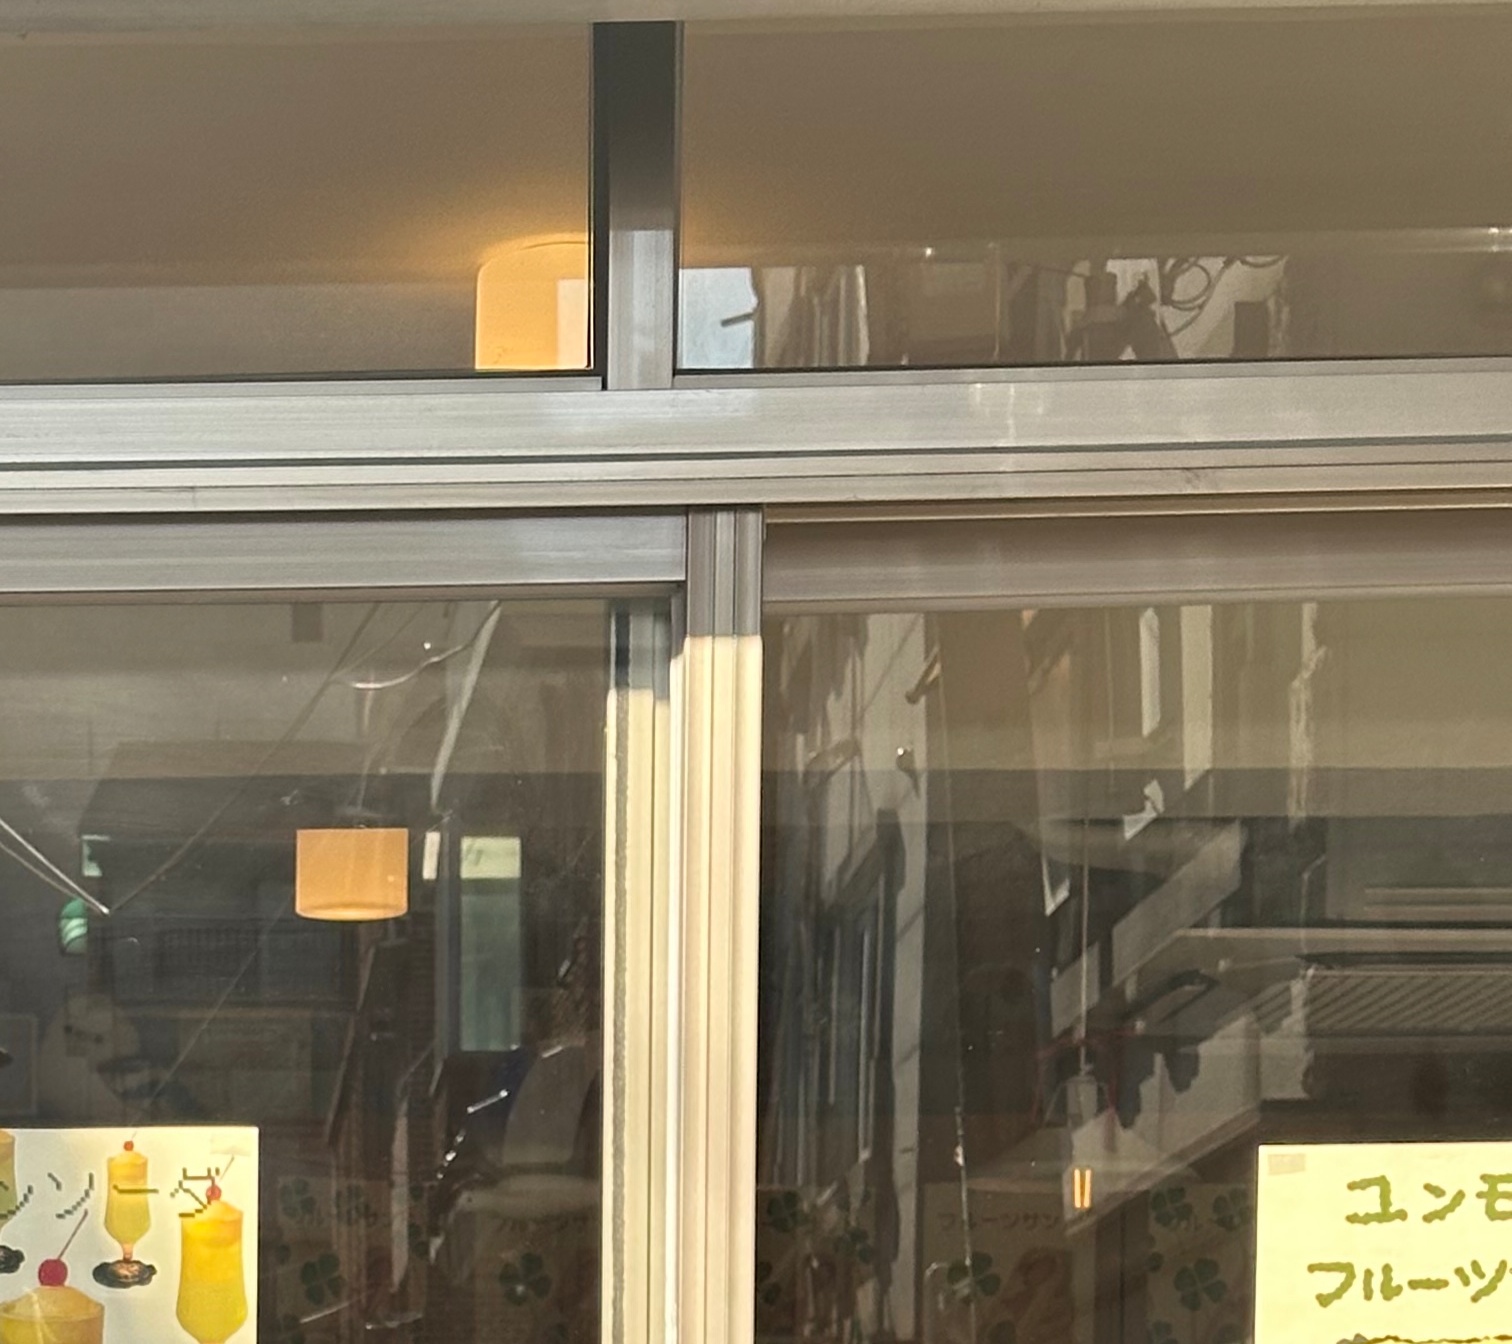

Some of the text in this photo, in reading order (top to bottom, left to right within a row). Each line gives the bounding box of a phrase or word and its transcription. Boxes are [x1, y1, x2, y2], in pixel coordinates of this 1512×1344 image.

[937, 1211, 1061, 1232] フルーツサン
[1307, 1259, 1512, 1308] フルーツ
